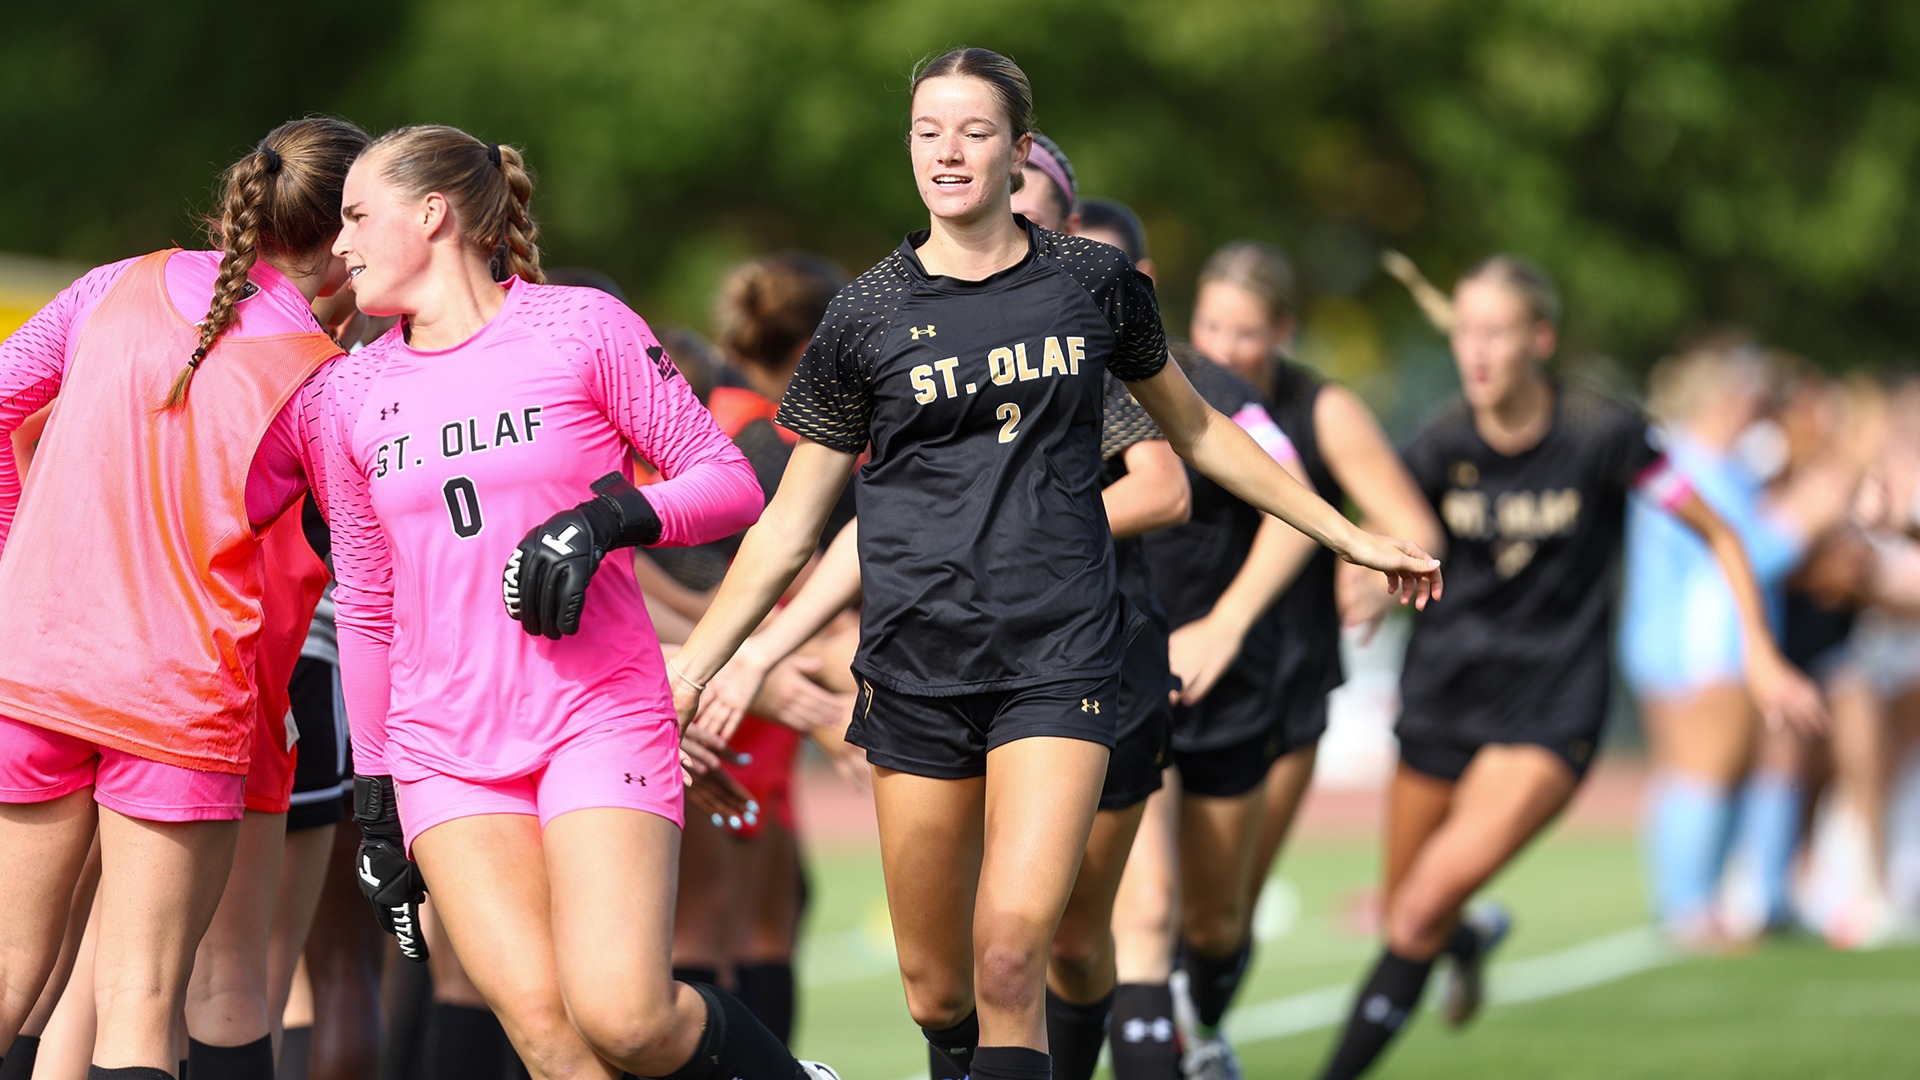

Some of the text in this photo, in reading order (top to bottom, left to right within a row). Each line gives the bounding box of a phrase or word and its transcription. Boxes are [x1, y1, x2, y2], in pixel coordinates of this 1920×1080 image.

[909, 336, 1086, 406] ST. OLAF
[376, 406, 543, 480] ST. OLAF
[996, 402, 1021, 444] 2
[442, 474, 485, 540] 0
